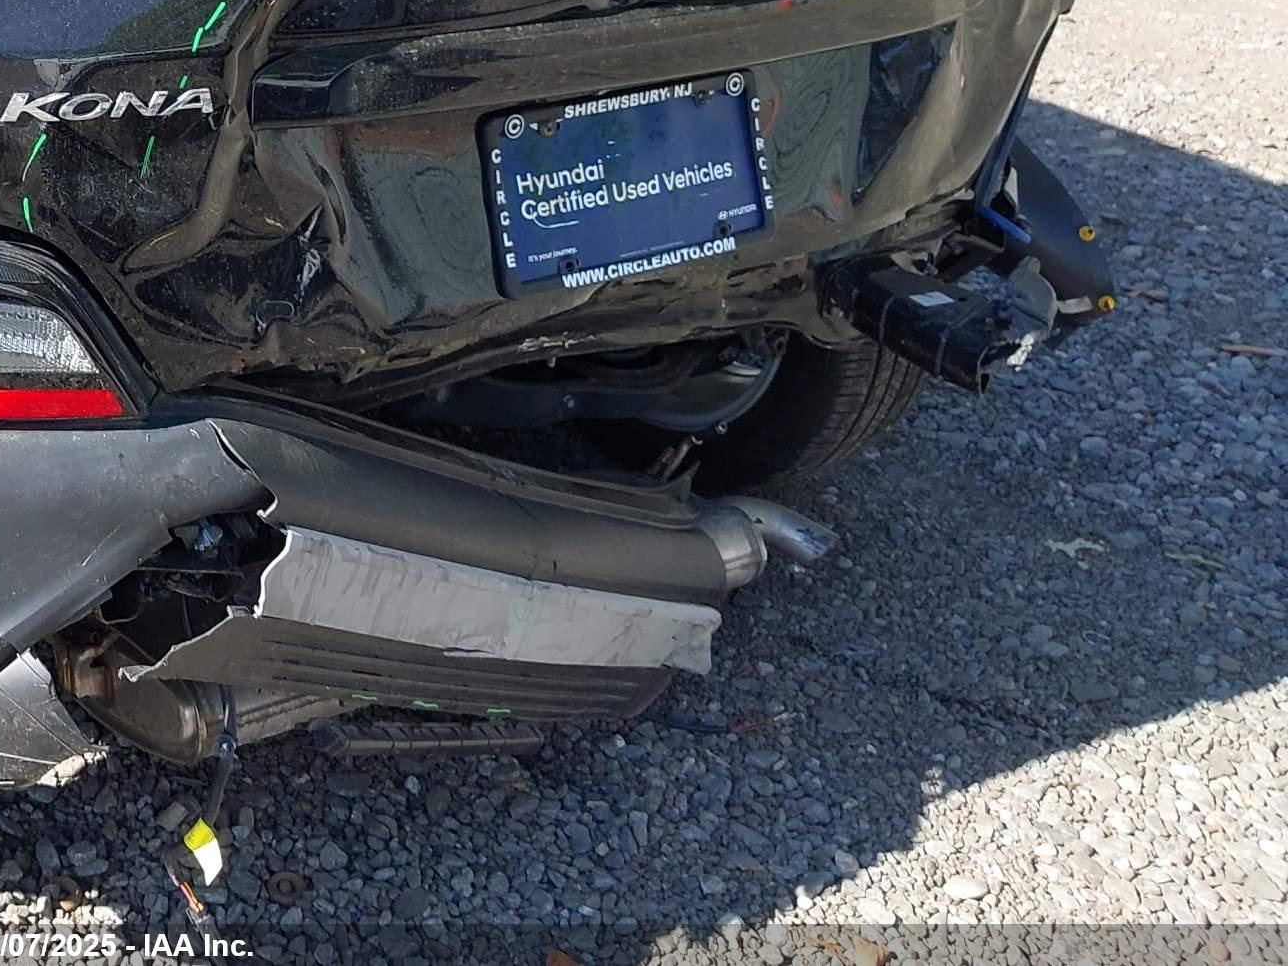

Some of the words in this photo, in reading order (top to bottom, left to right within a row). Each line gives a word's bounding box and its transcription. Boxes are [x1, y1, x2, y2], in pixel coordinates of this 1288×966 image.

[0, 87, 214, 123] KONA
[674, 82, 692, 98] NJ
[751, 97, 774, 211] CIRCLE
[516, 158, 604, 195] Hyundai
[521, 184, 609, 220] Certified
[612, 174, 661, 202] Used
[663, 161, 733, 191] Vehicles
[491, 148, 516, 268] CIRCLE
[728, 203, 757, 217] HYUNDAI
[528, 253, 539, 263] It's
[539, 251, 553, 262] your
[562, 236, 736, 288] WWW.CIRCLEAUTO.COM
